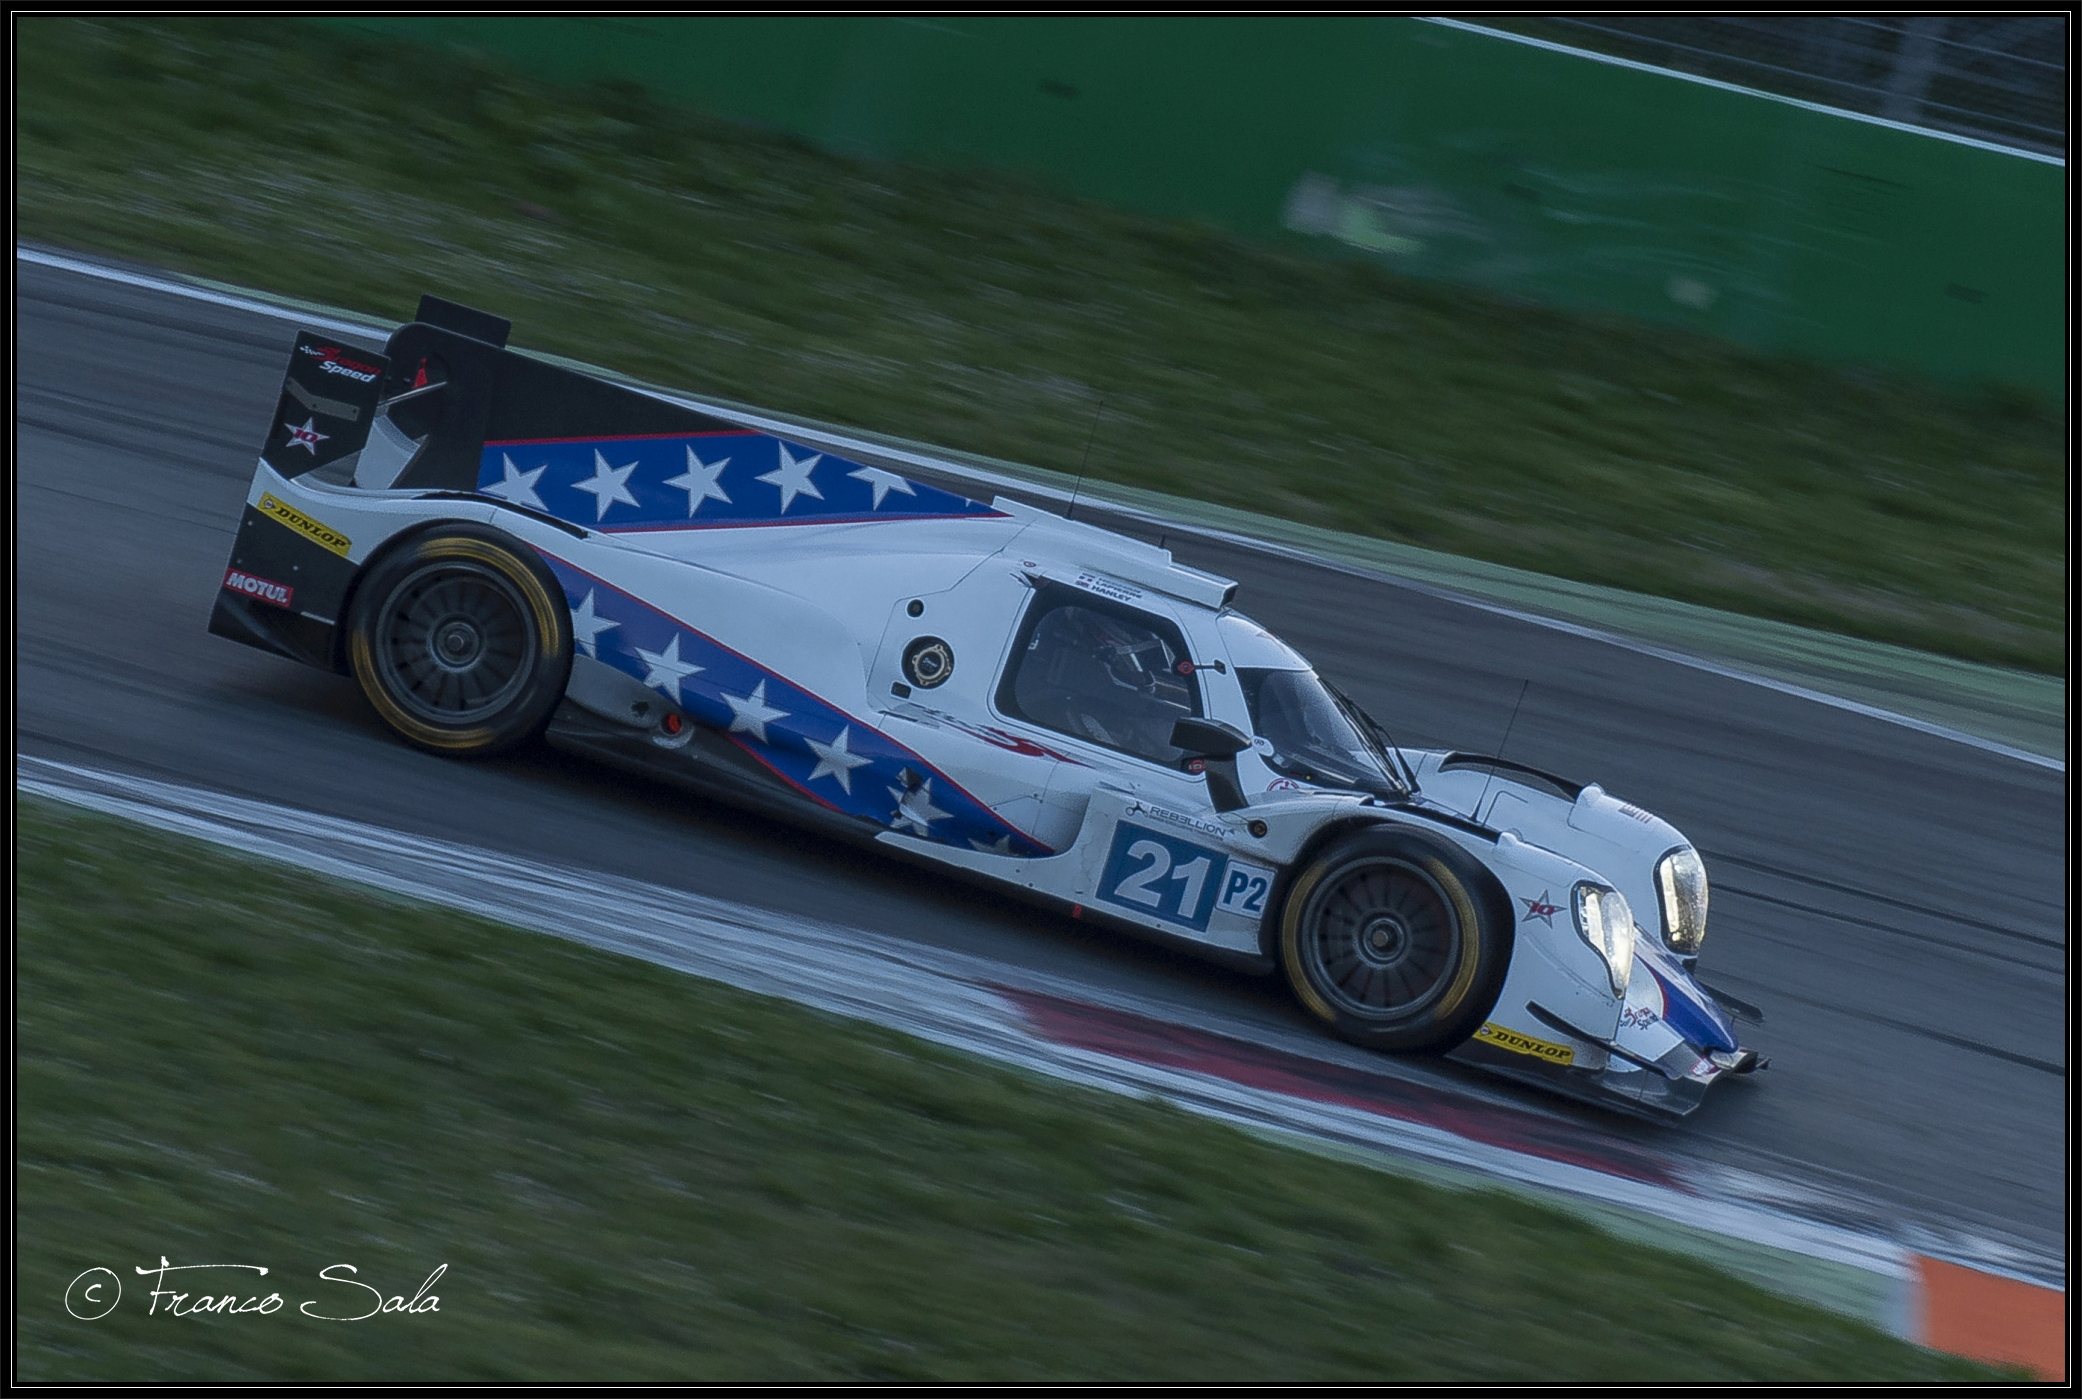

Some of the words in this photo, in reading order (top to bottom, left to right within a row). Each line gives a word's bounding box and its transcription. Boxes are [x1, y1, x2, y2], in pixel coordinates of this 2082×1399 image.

[319, 360, 377, 383] Speed
[274, 508, 347, 548] DUNLOP
[226, 572, 288, 603] MOTUL
[1091, 585, 1131, 602] HANLEY
[1113, 839, 1212, 919] 21
[1222, 869, 1268, 912] P2
[1530, 901, 1556, 916] 10
[1492, 1030, 1571, 1059] DUNLOP
